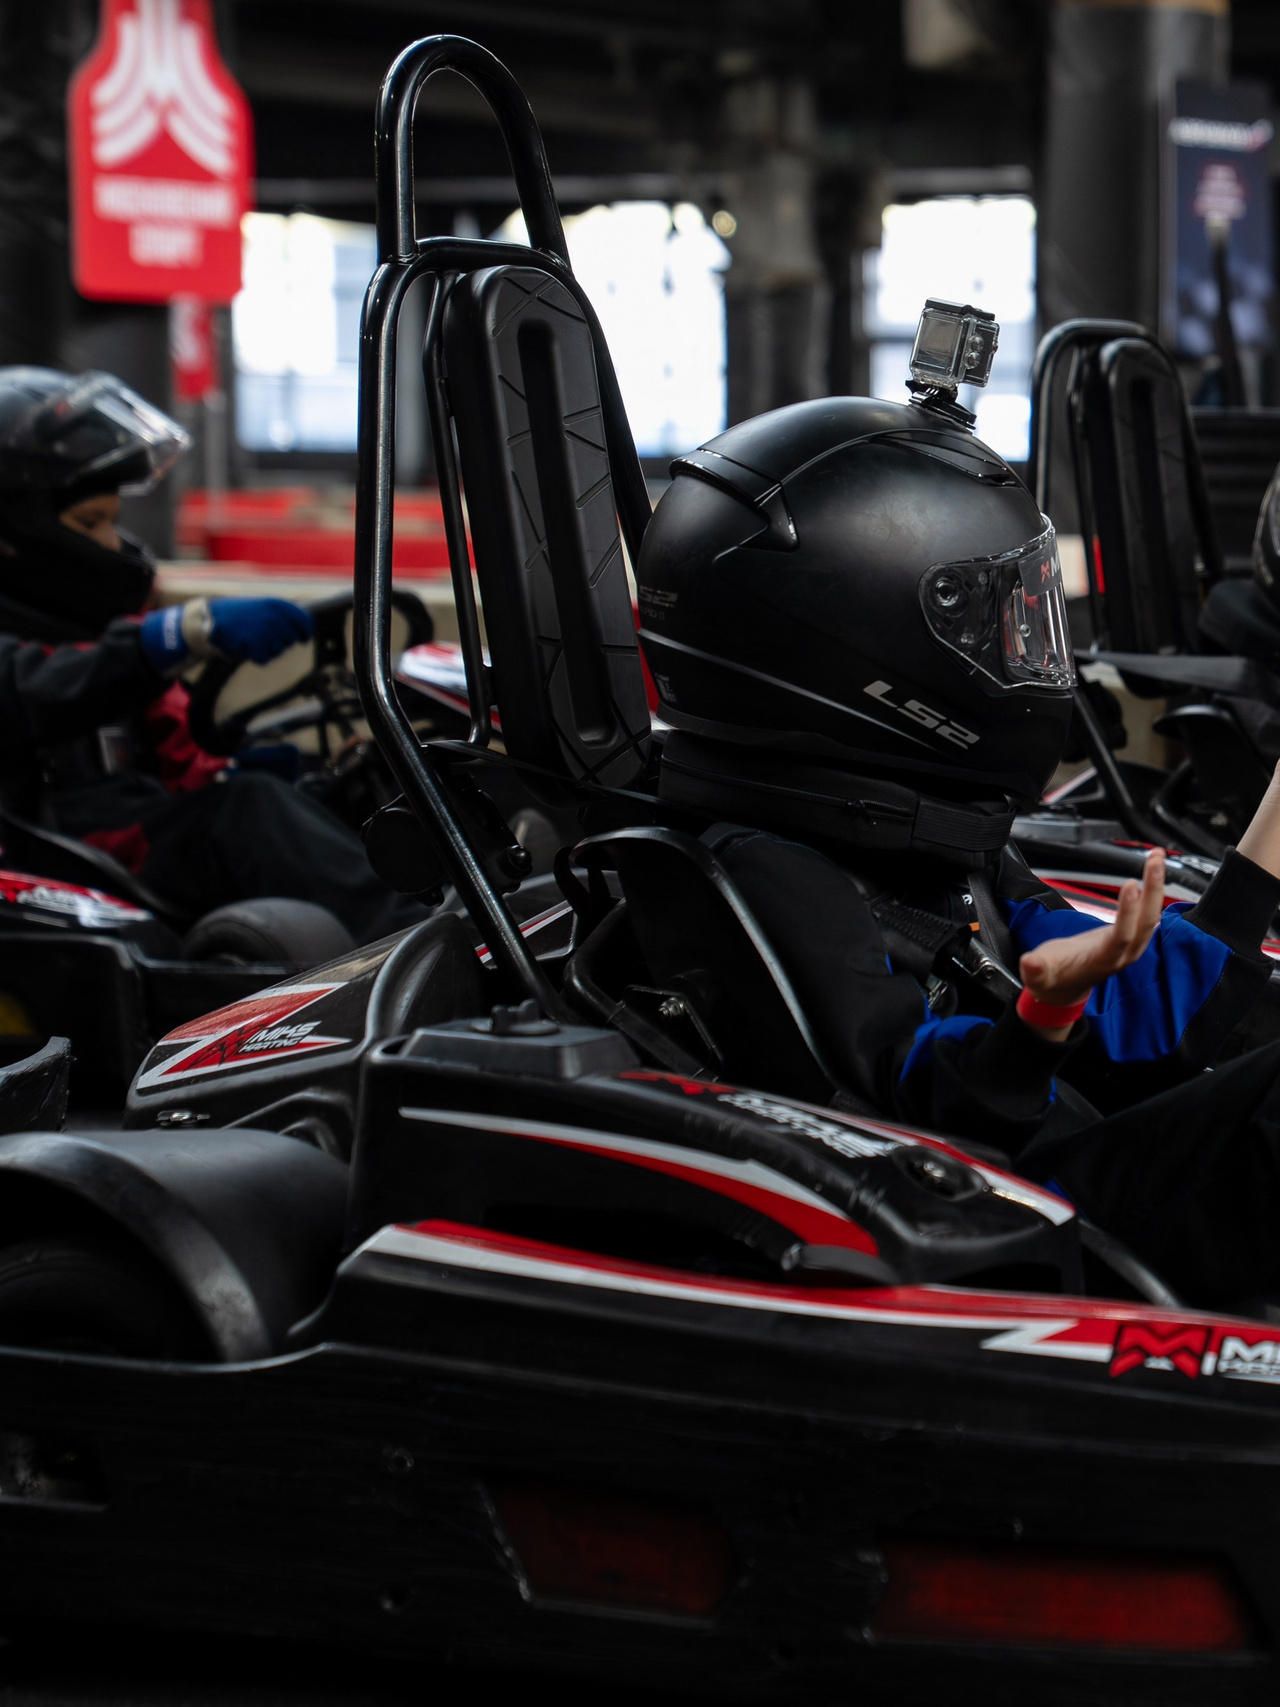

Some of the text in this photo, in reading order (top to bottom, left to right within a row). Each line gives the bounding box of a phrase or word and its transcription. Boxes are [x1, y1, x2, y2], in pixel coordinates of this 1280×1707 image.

[863, 680, 980, 750] LS2
[246, 1020, 323, 1044] MIKS
[238, 1036, 301, 1054] KARTING
